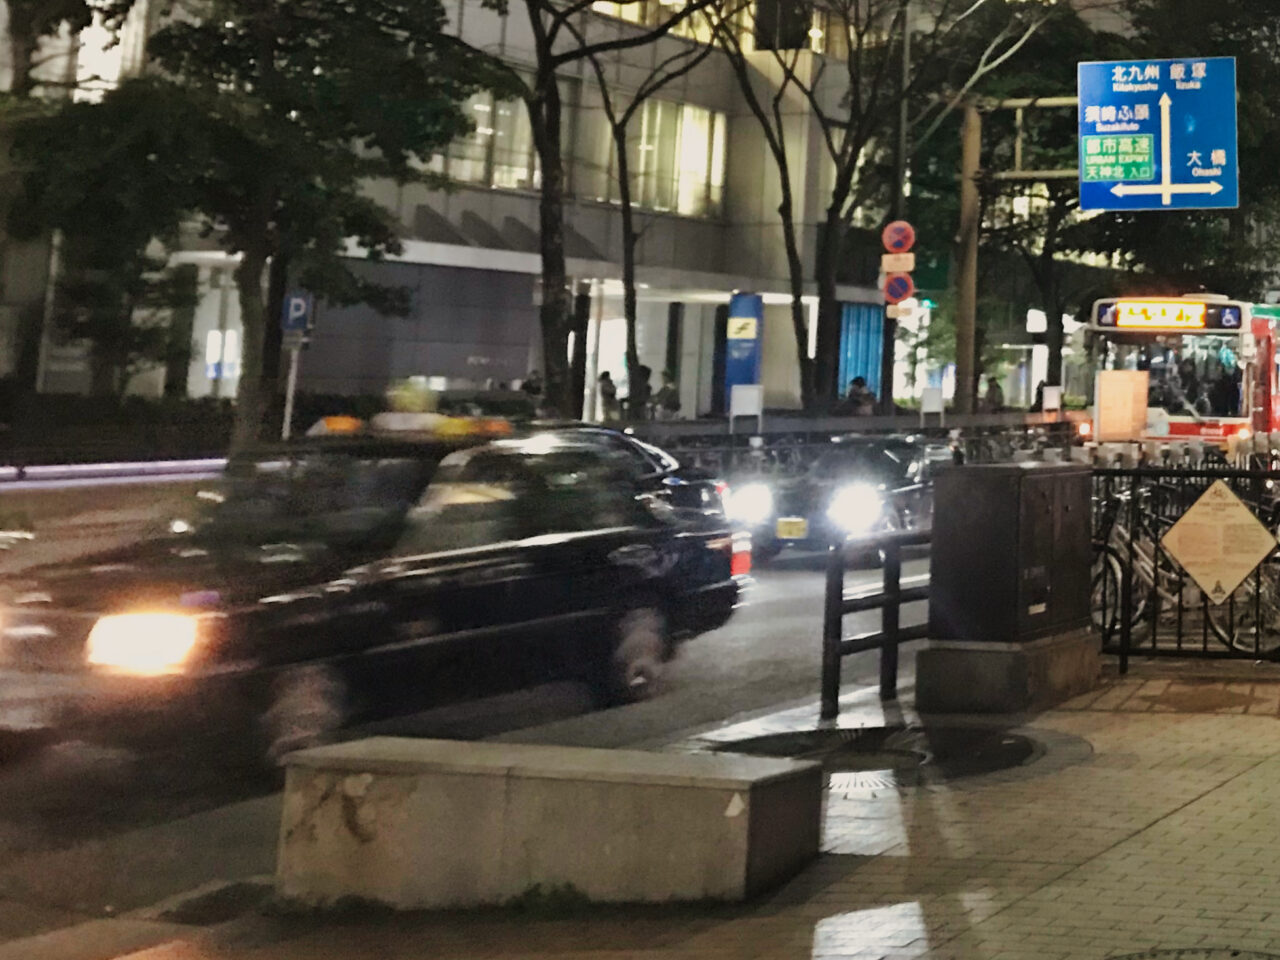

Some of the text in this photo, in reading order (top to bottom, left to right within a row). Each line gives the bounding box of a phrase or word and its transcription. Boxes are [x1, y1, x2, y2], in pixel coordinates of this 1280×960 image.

[1112, 65, 1160, 81] 北九州
[1130, 167, 1150, 178] 入口
